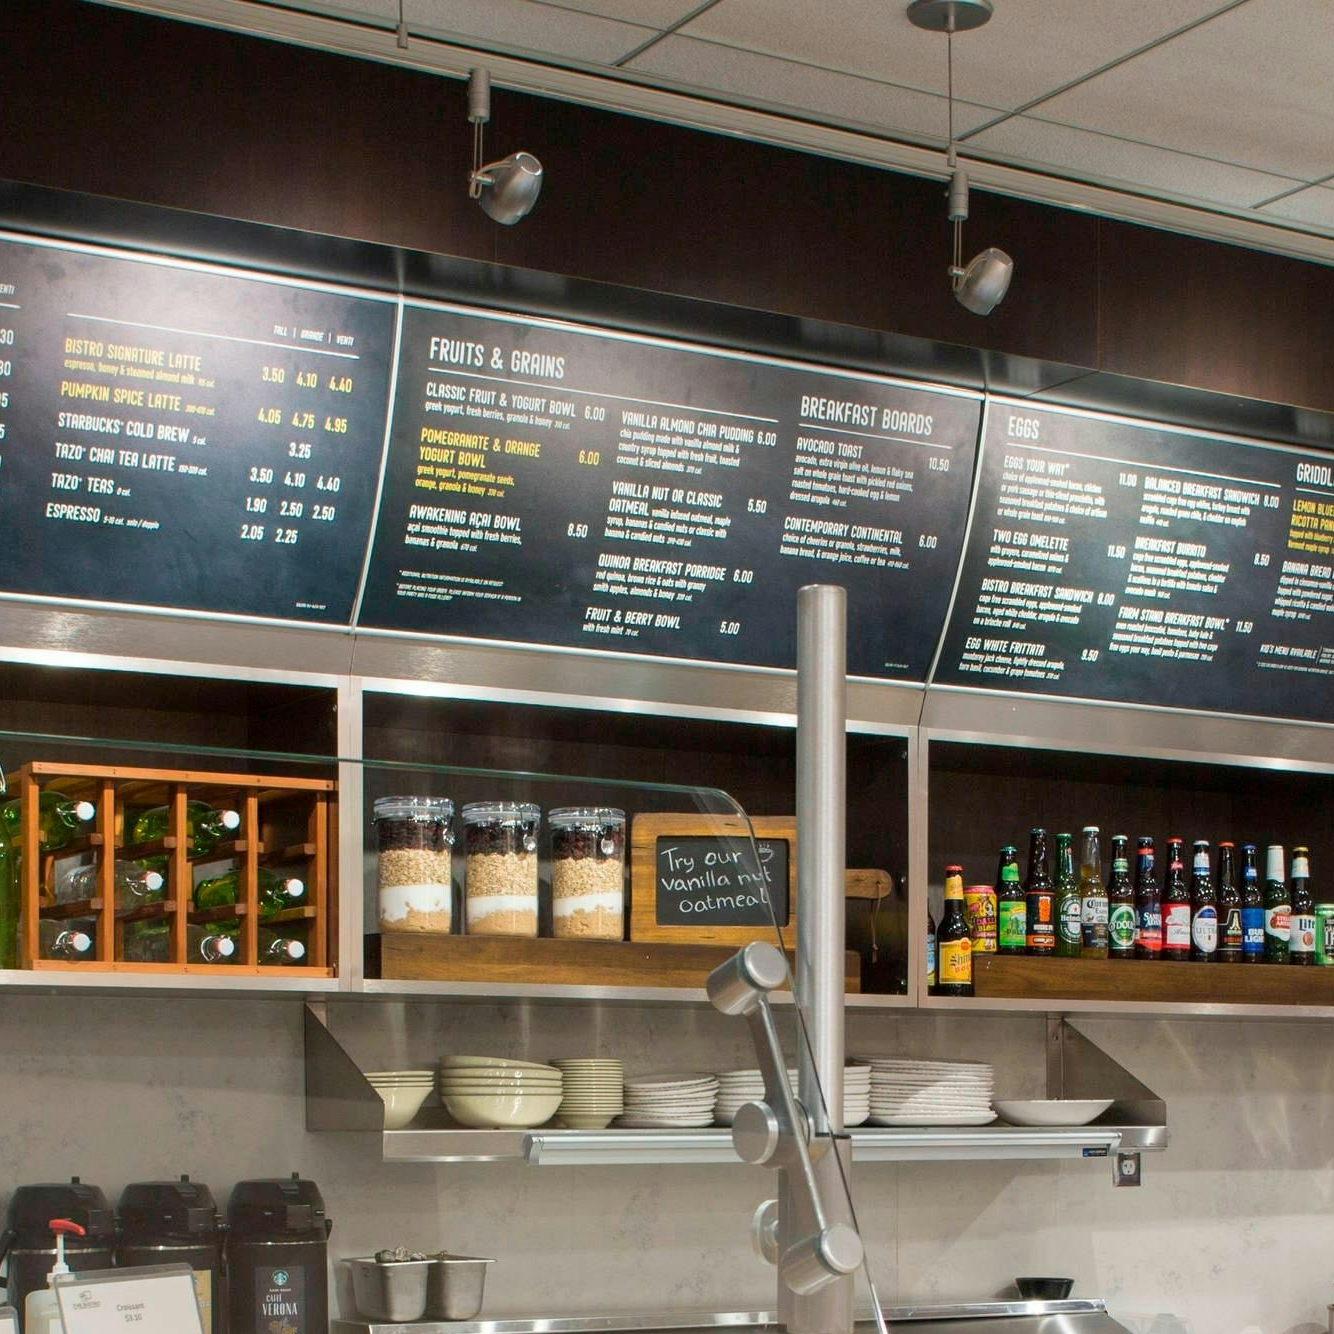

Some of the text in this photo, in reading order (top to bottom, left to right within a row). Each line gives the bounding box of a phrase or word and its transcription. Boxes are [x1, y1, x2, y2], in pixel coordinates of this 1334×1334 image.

[66, 338, 201, 372] BISTRO SIGNATURE LATTE
[430, 337, 565, 379] FRUITS & GRAINS
[61, 382, 181, 411] PUMPKIN SPICE LATTE
[427, 382, 604, 421] CLASSIC FRUIT & YOGURT BOWL 6.00
[622, 411, 776, 446] VANILLA ALMOND CHIA PUDDING 6.00
[801, 396, 933, 435] BREAKFAST BOARDS
[1008, 415, 1039, 439] EGGS
[127, 420, 153, 439] COLD
[158, 425, 189, 443] BREW
[421, 428, 540, 457] POMEGRANATE & ORANGE
[90, 448, 114, 464] CHAI
[119, 451, 138, 467] TEA
[142, 454, 175, 472] LATTE
[289, 443, 311, 458] 3.25
[419, 447, 600, 468] YOGURT BOWL 6.00
[797, 437, 949, 471] AVOCADO TOAST 10.50
[87, 477, 114, 494] TEAS
[46, 503, 100, 522] ESPRESSO
[1293, 500, 1316, 514] LEMON
[409, 505, 588, 538] AWAKENING AÇAI BOWL 8.50
[784, 517, 937, 548] CONTEMPORARY CONTINENTAL 6.00
[1291, 514, 1318, 528] RICOTTA
[982, 578, 1115, 606] BISTRO BREAKFAST SANDWICH 8.00
[586, 607, 740, 635] FRUIT & BERRY BOWL 5.00
[966, 637, 1099, 661] EGG WHITE FRITTATA 9.50
[661, 847, 742, 874] Try our
[661, 865, 772, 891] vanilla nut
[679, 889, 769, 913] oatmeal
[262, 1303, 297, 1315] VERONA
